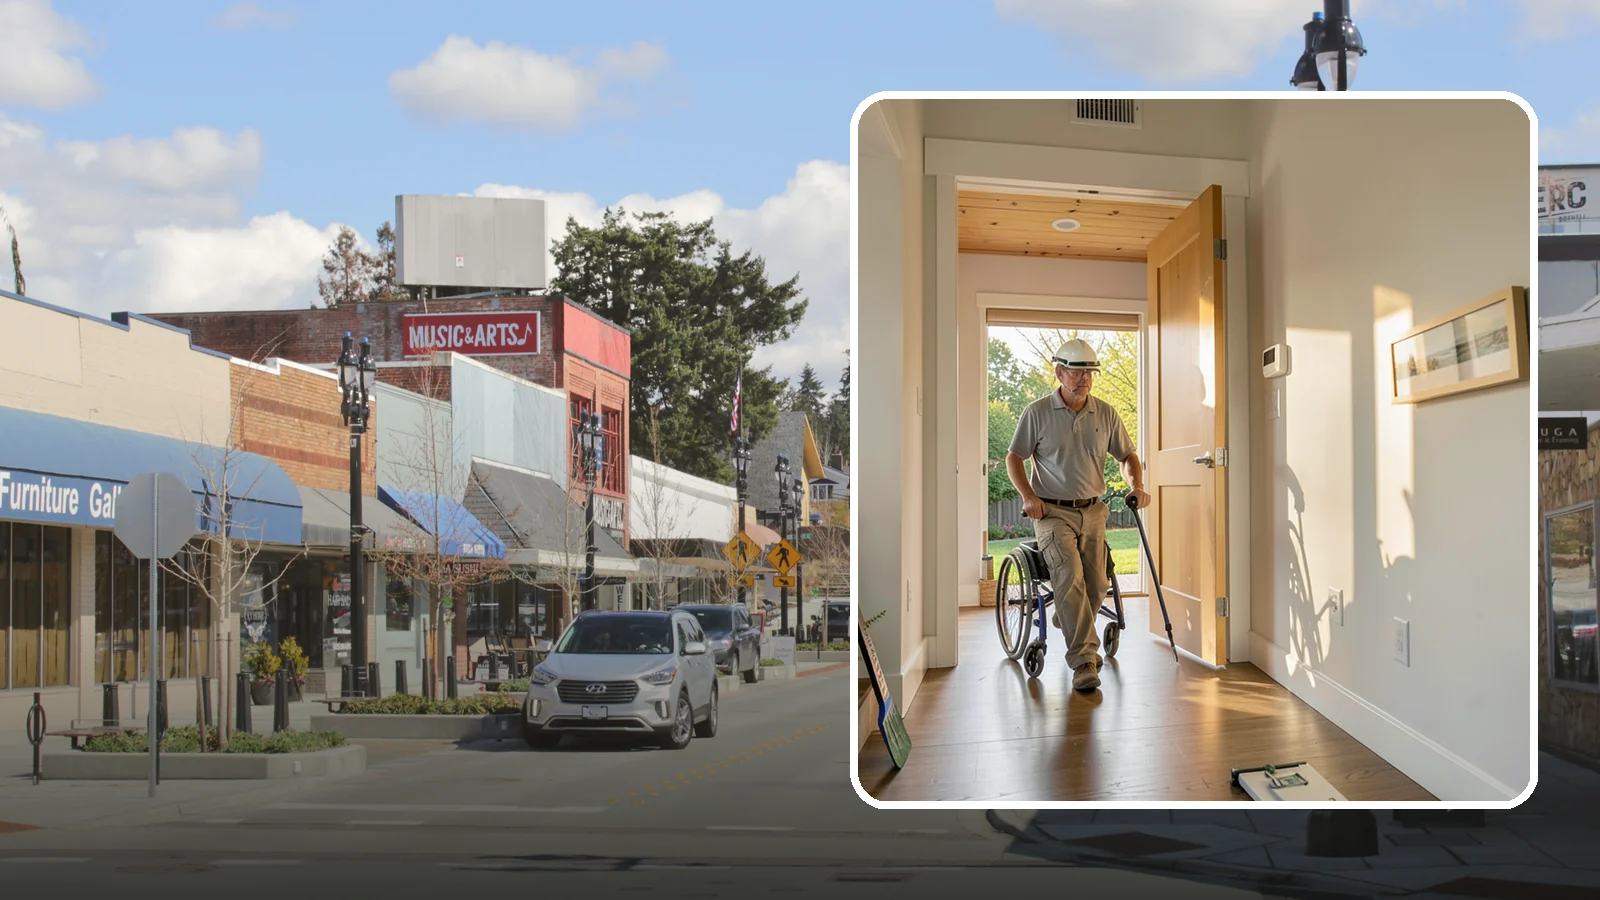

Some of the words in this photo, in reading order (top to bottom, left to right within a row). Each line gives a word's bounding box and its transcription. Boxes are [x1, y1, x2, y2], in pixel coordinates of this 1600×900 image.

[0, 471, 79, 515] Furniture
[89, 482, 121, 519] Gal
[453, 563, 479, 574] SUSHI
